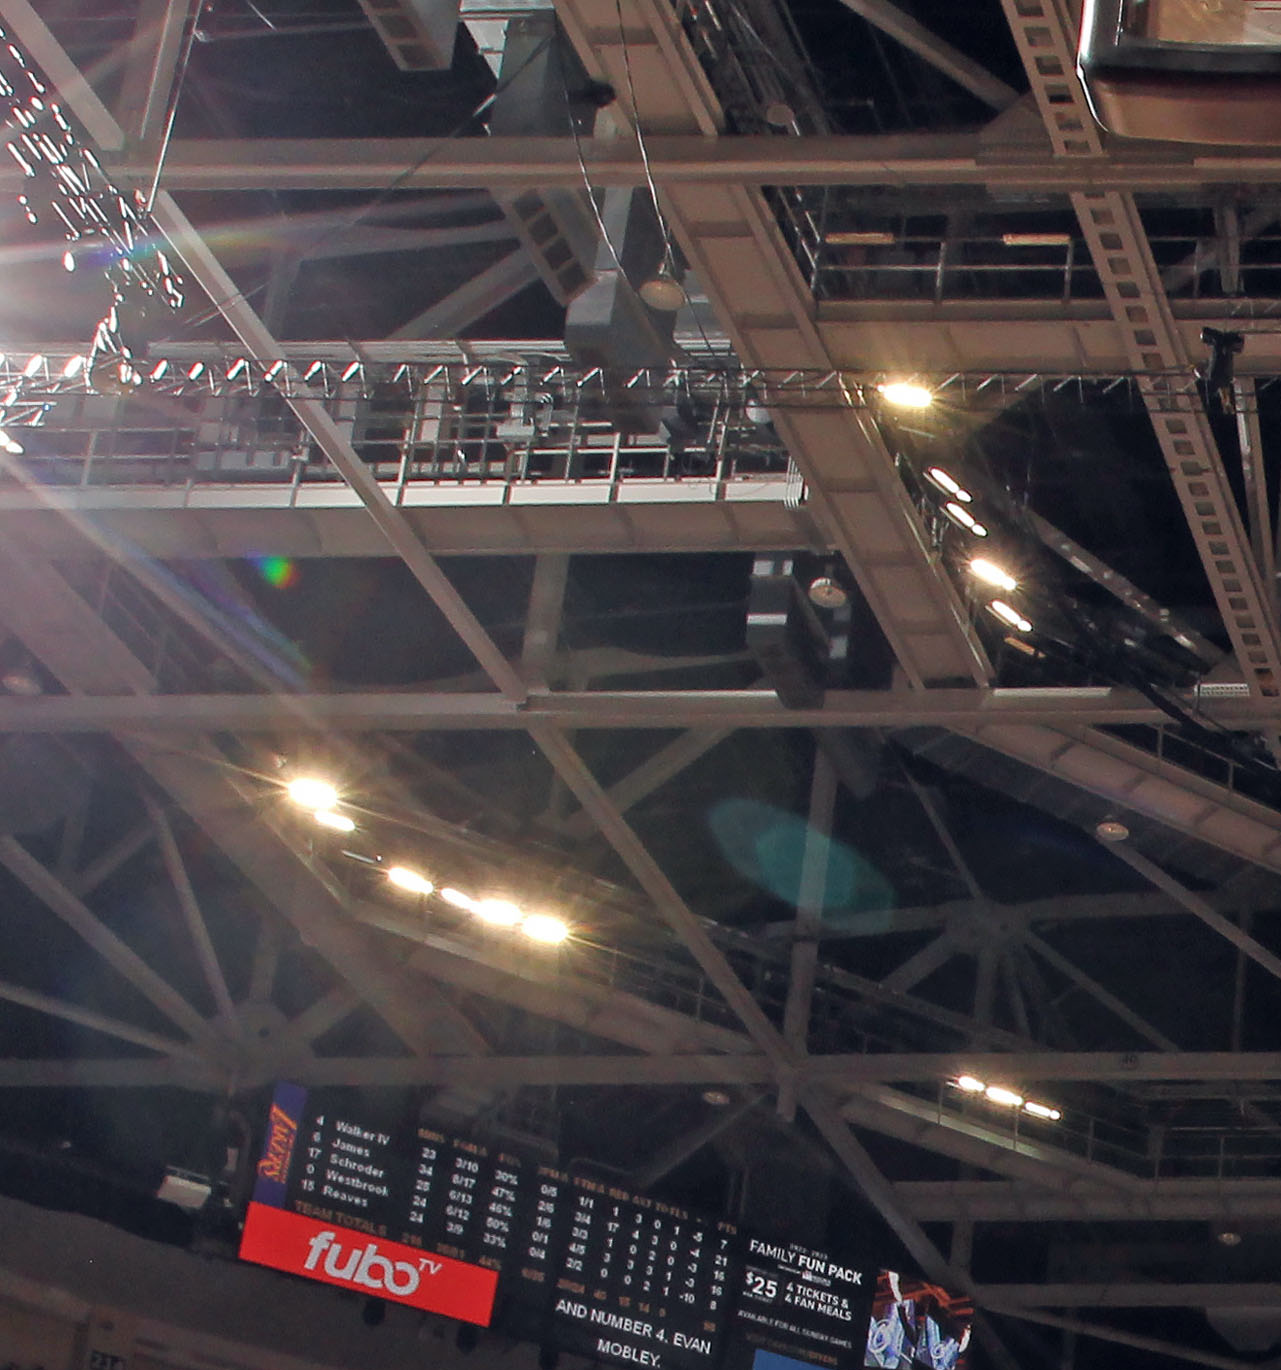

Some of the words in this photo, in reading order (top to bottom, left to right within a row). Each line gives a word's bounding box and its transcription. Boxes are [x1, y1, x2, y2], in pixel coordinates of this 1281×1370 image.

[334, 1121, 375, 1144] Walker
[331, 1139, 369, 1159] James
[329, 1152, 383, 1180] Schroder
[323, 1183, 369, 1207] Reaves
[325, 1167, 388, 1198] Westbrook
[304, 1231, 419, 1295] fubo
[419, 1258, 442, 1274] TV
[750, 1239, 798, 1266] FAMILY
[798, 1255, 825, 1273] FUN
[828, 1264, 863, 1286] PACK
[745, 1271, 778, 1299] $25
[786, 1282, 793, 1292] 4
[797, 1285, 840, 1305] TICKETS
[841, 1298, 849, 1309] &
[785, 1292, 791, 1302] 4
[794, 1295, 814, 1311] FAN
[816, 1302, 852, 1322] MEALS
[556, 1299, 588, 1319] AND
[590, 1309, 652, 1338] NUMBER
[656, 1328, 668, 1343] 4.
[673, 1332, 711, 1354] EVAN
[597, 1339, 661, 1367] MOBLEY.
